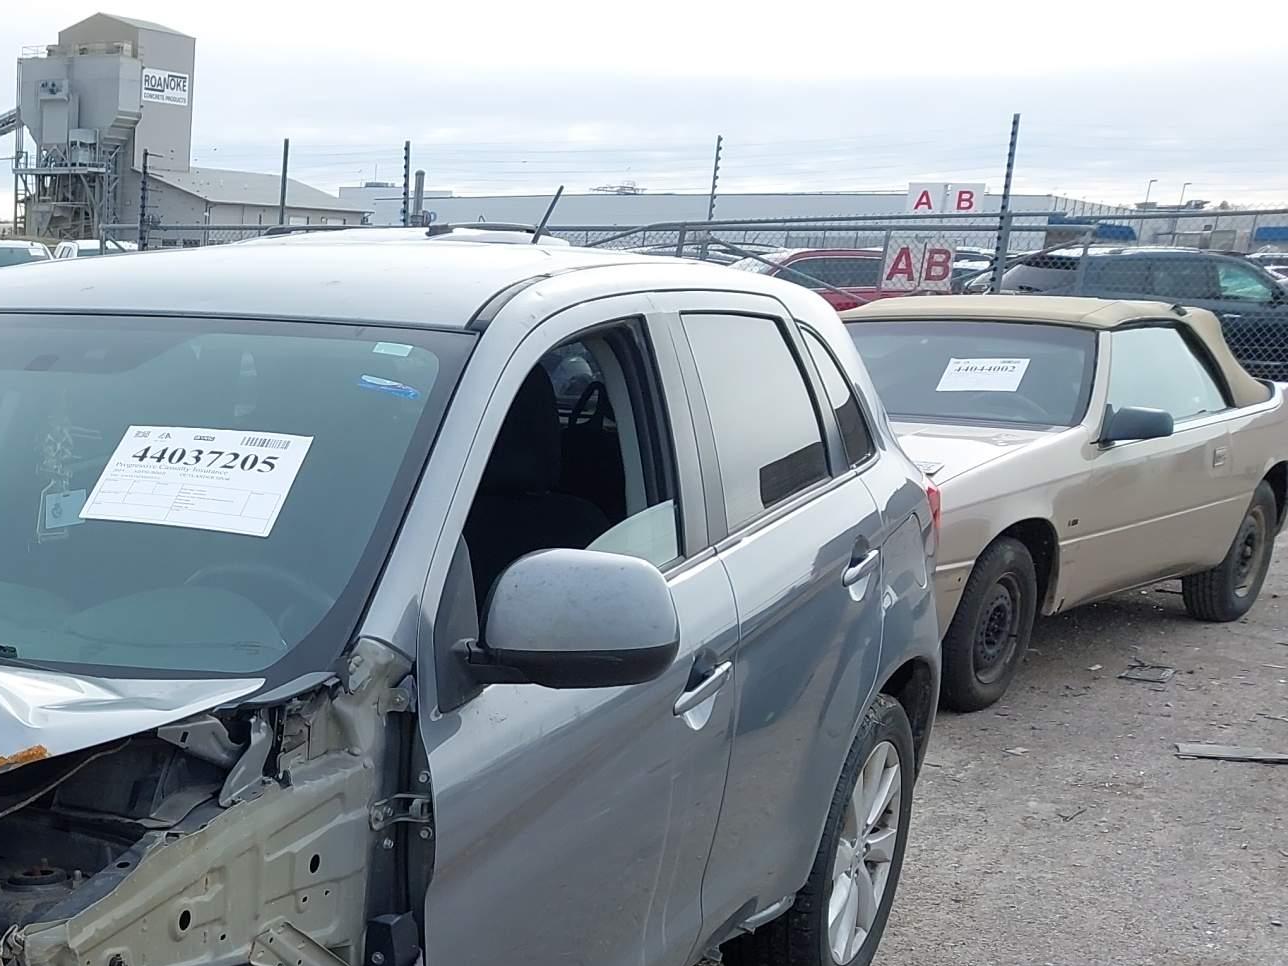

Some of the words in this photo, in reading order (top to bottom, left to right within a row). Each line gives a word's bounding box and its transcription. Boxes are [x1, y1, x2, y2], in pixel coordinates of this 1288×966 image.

[144, 74, 187, 92] ROANOKE
[913, 190, 932, 210] A
[956, 190, 974, 210] B
[132, 446, 280, 473] 44037205
